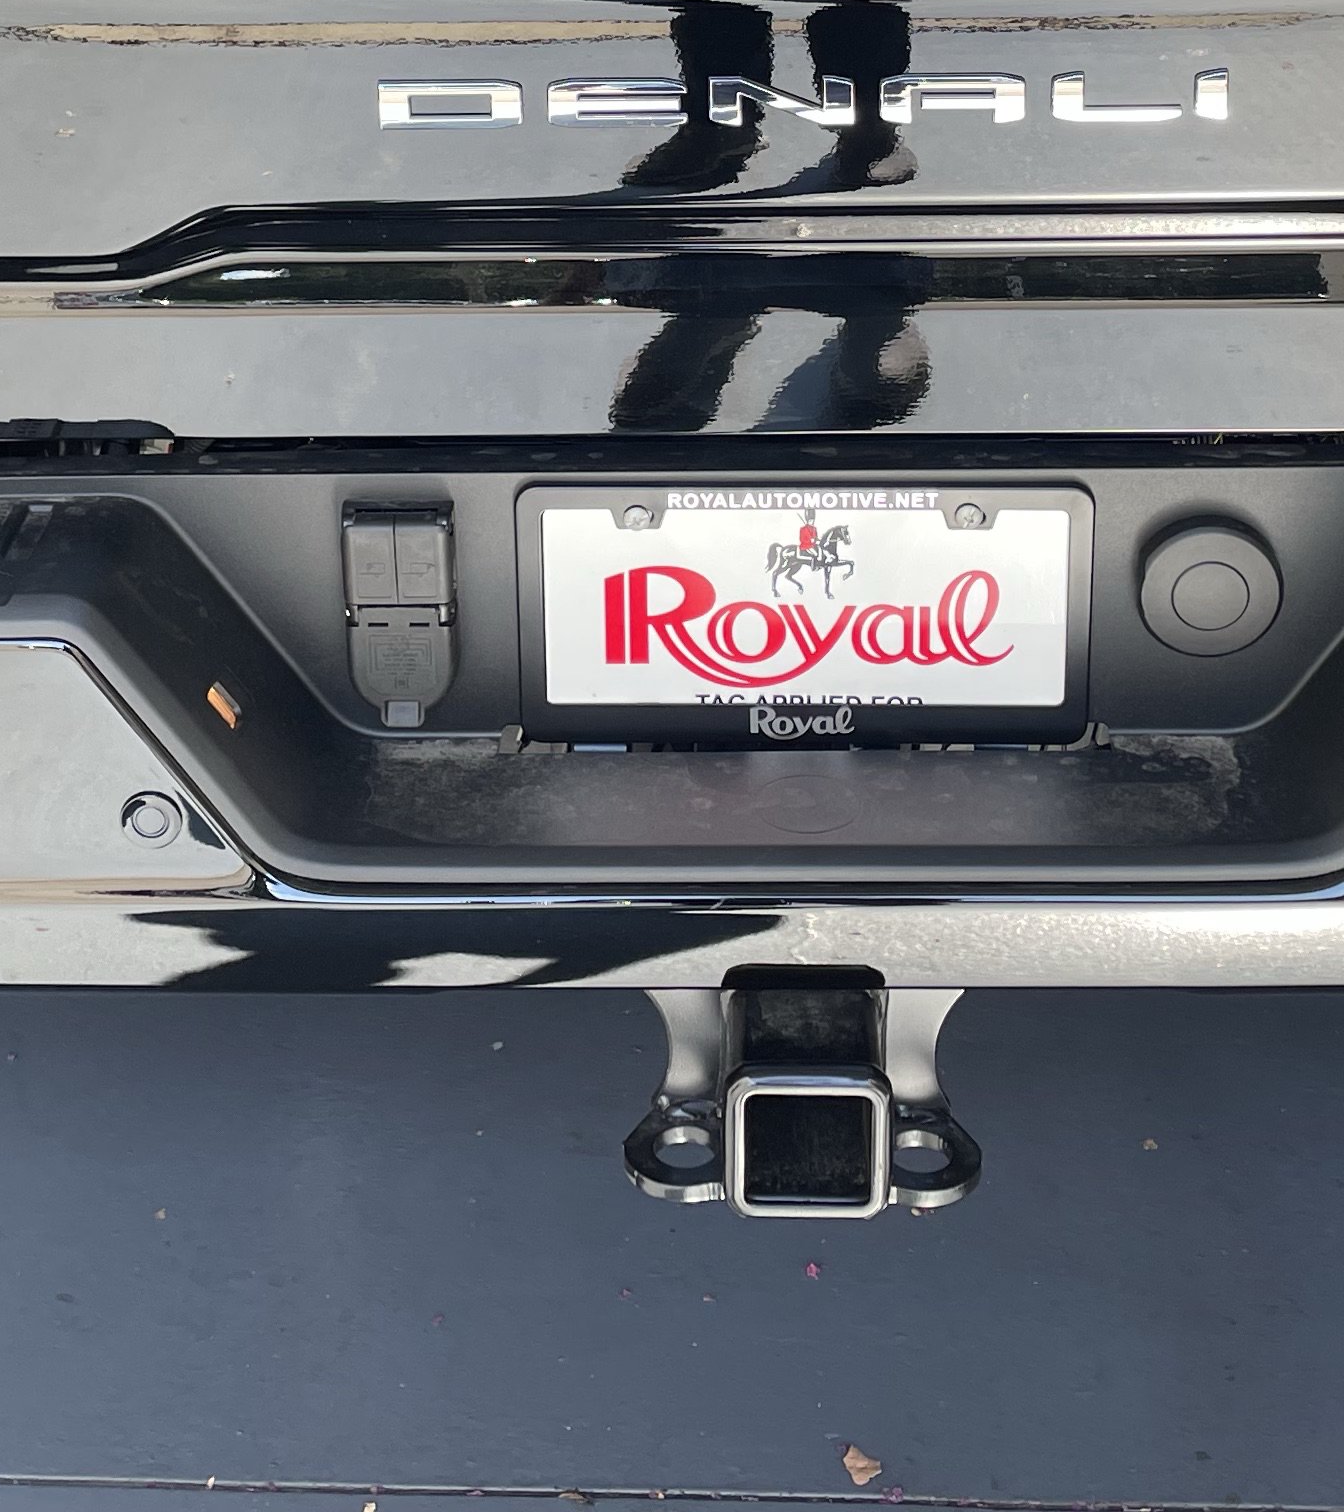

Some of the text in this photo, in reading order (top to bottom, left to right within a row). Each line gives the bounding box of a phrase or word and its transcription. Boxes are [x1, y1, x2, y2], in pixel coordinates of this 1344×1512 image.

[377, 68, 1229, 130] DENALI
[667, 492, 939, 509] ROYALAUTOMOTIVE.NET
[604, 565, 1014, 688] Royal
[750, 705, 855, 740] Royal
